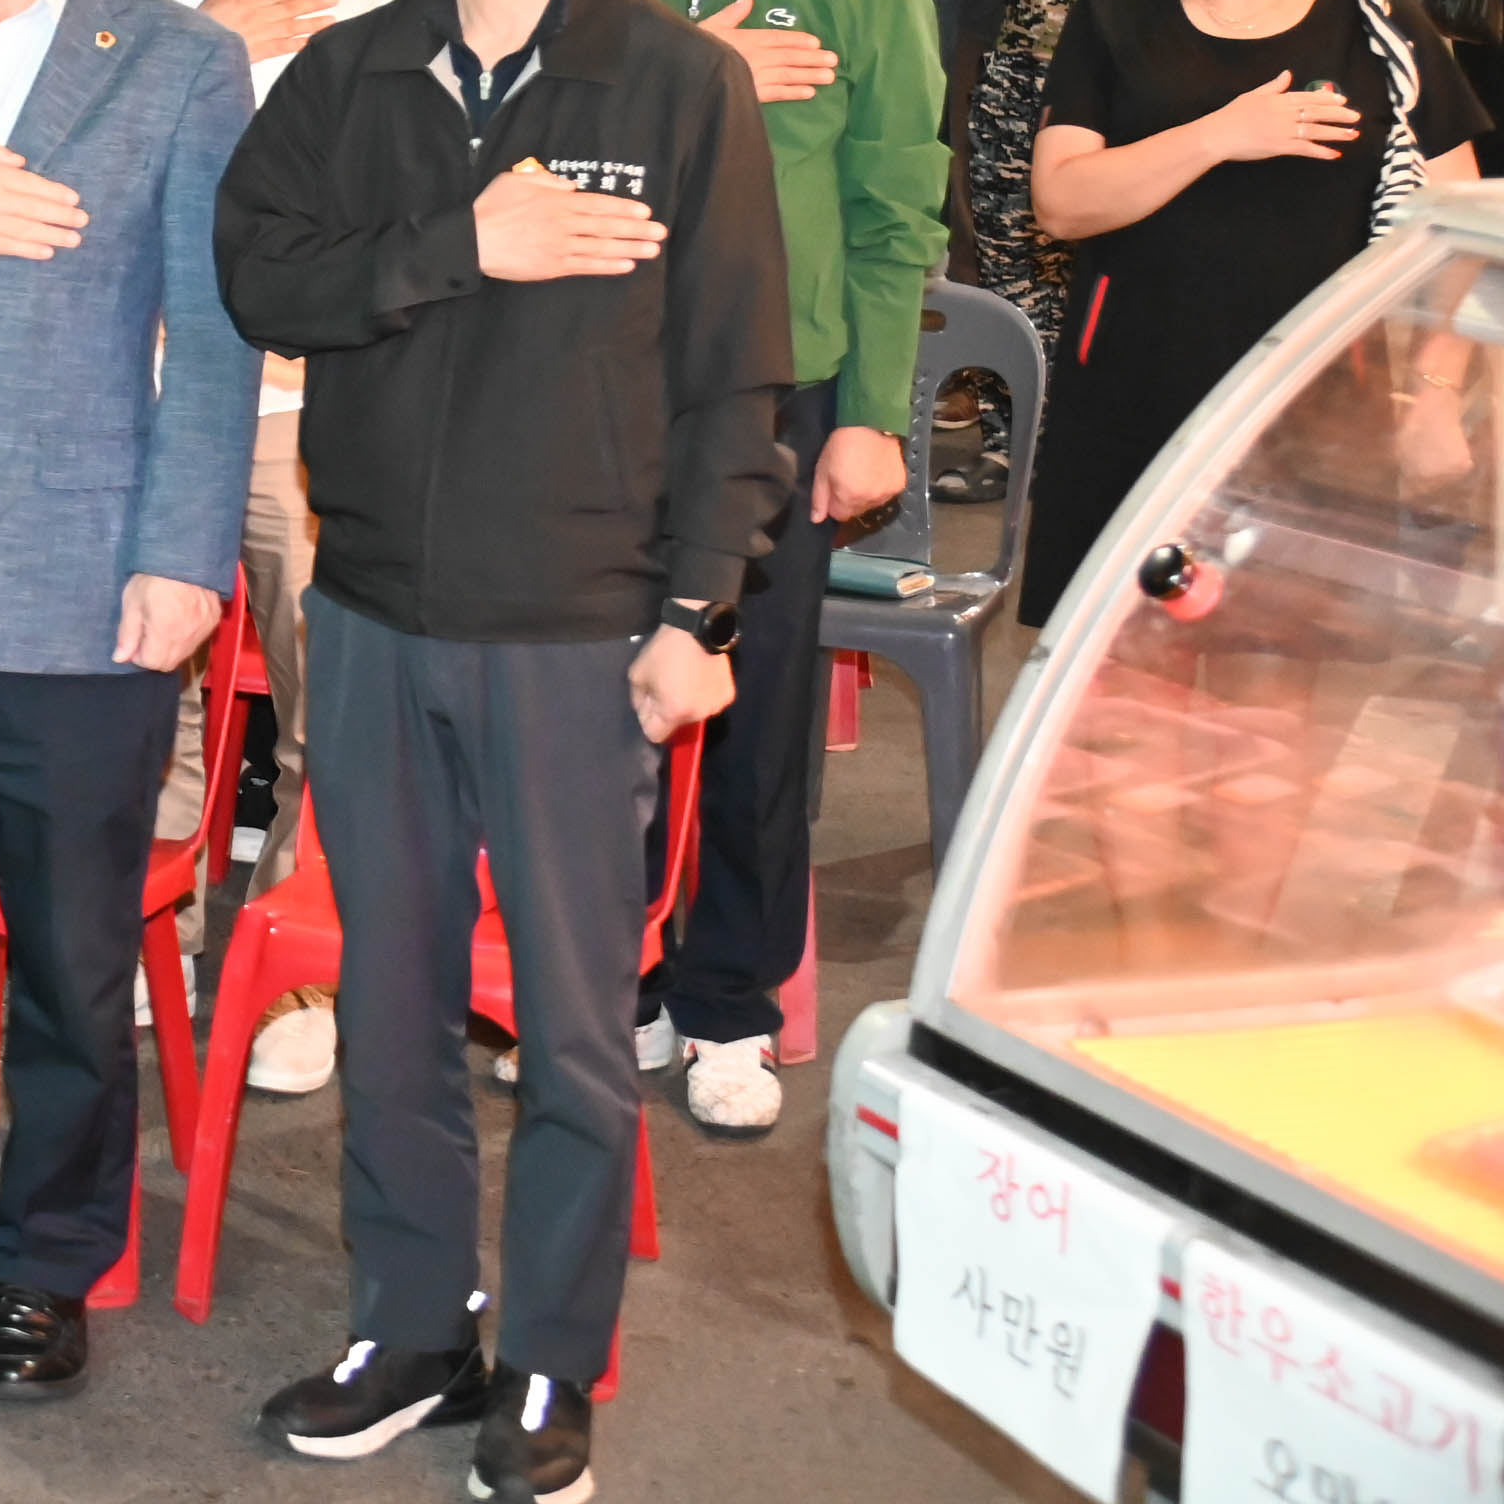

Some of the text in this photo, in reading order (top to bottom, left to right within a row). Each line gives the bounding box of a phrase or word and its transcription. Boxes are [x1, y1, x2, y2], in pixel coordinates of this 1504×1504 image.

[976, 1148, 1071, 1256] 장어
[951, 1264, 1087, 1400] 사만원
[1200, 1273, 1483, 1495] 한우소고기
